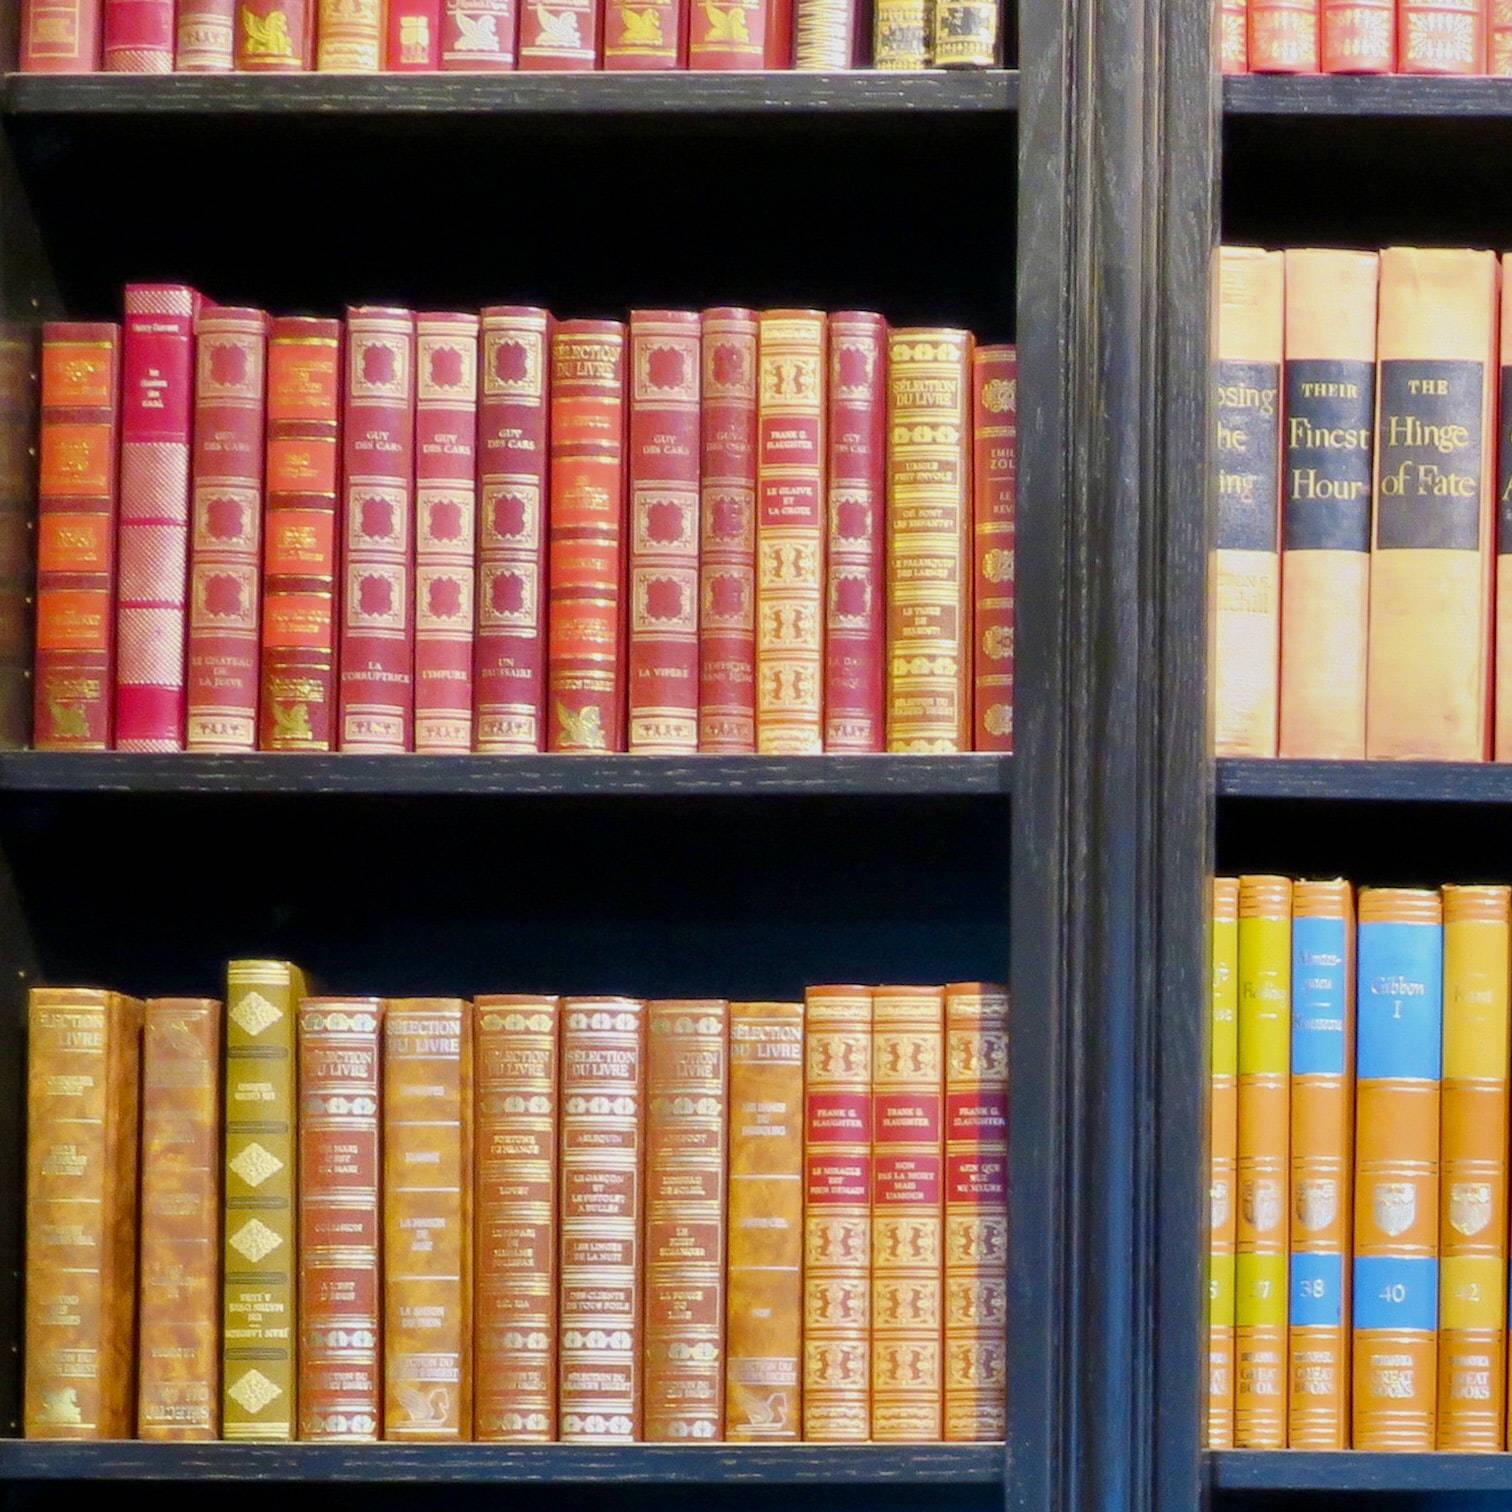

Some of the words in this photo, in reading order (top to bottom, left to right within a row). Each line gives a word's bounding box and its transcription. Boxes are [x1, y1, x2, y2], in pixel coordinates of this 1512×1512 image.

[1301, 383, 1357, 398] THEIR
[1408, 380, 1448, 395] THE
[488, 438, 508, 449] DES
[510, 438, 536, 449] CARS
[498, 429, 522, 438] GUY
[1289, 425, 1370, 451] Finest
[1389, 418, 1468, 451] Hinge
[1292, 476, 1362, 502] Hour
[1382, 464, 1414, 495] of
[1418, 468, 1475, 498] Fate
[1371, 977, 1425, 998] Gibbon
[1393, 1001, 1402, 1021] I
[1379, 1284, 1405, 1302] 40
